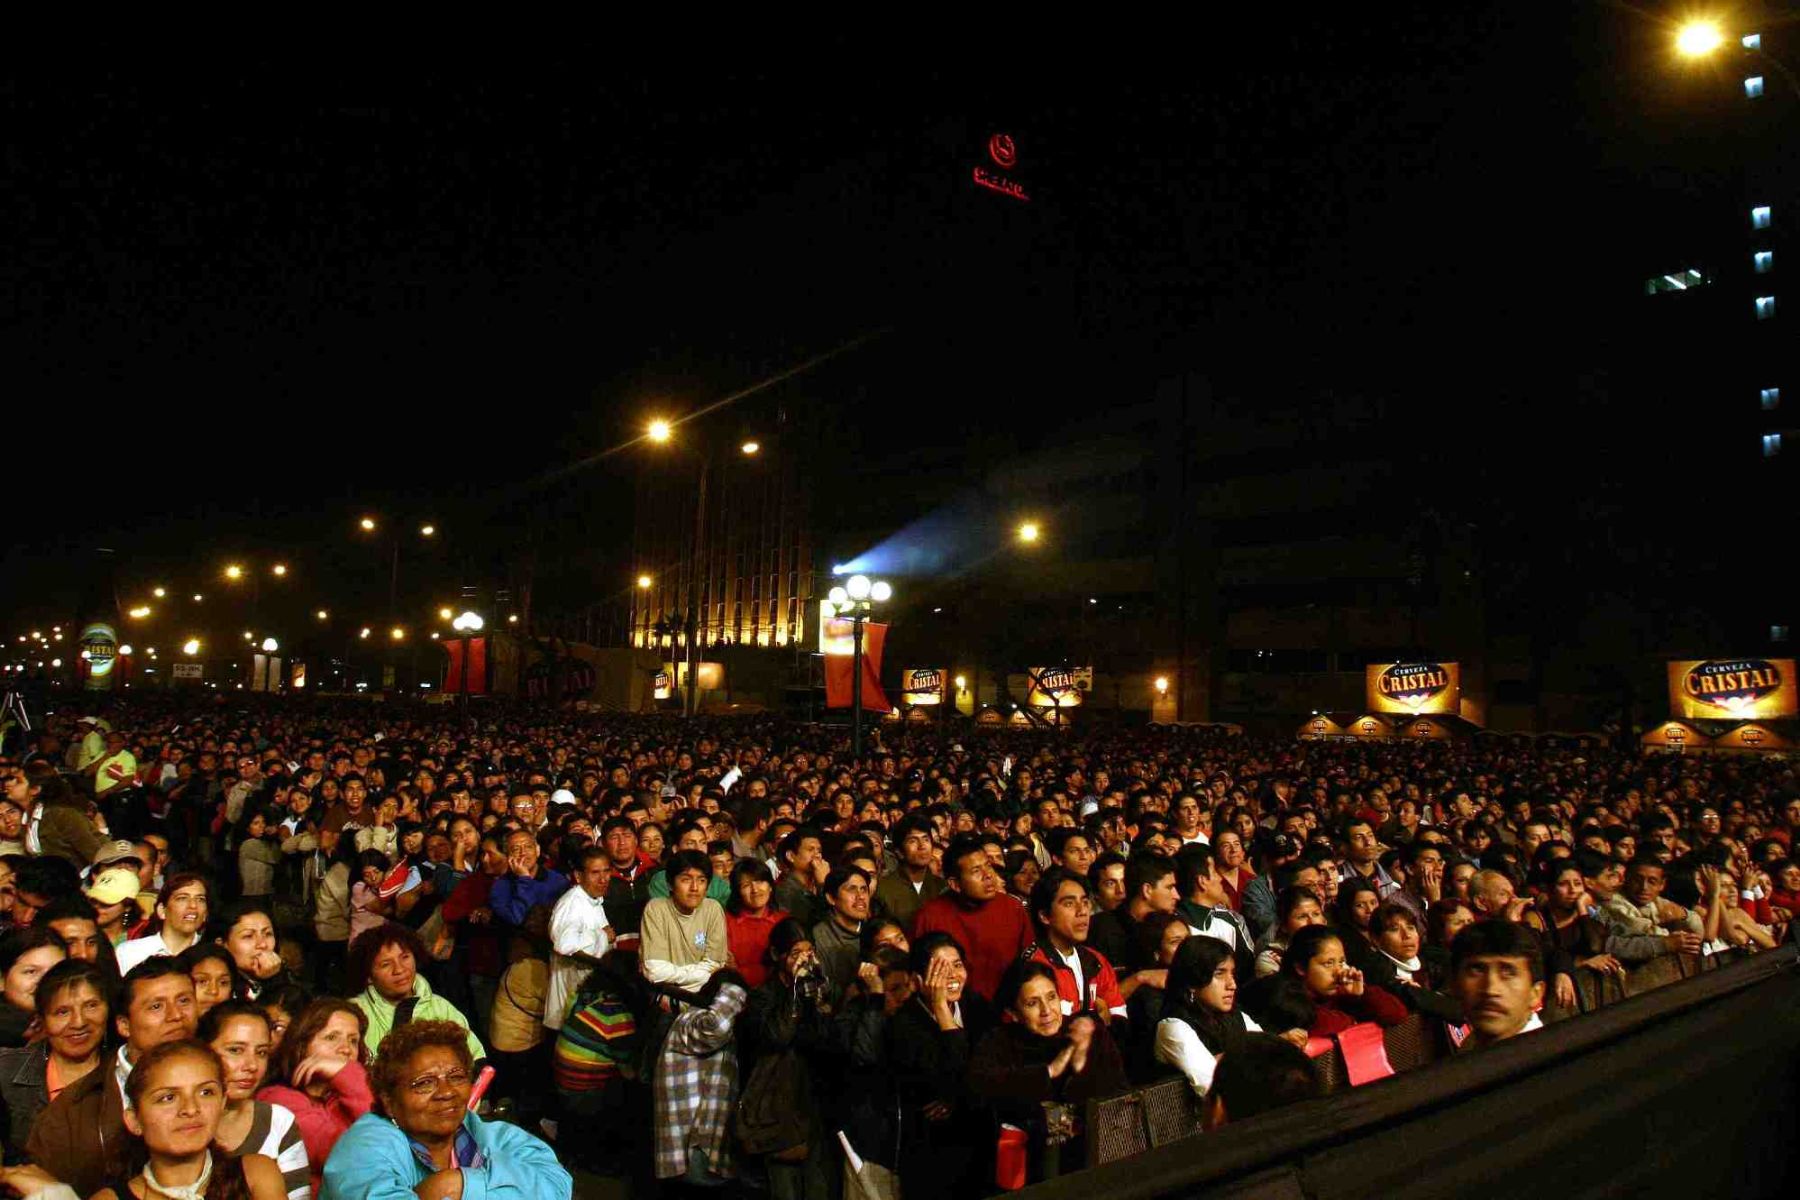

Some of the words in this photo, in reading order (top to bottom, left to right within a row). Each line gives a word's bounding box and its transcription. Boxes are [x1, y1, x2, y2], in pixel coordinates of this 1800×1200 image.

[1394, 666, 1428, 676] CERVEZA
[1705, 663, 1752, 674] CERVEZA
[1380, 671, 1447, 693] CRISTAL
[1686, 669, 1779, 695] CRISTAL
